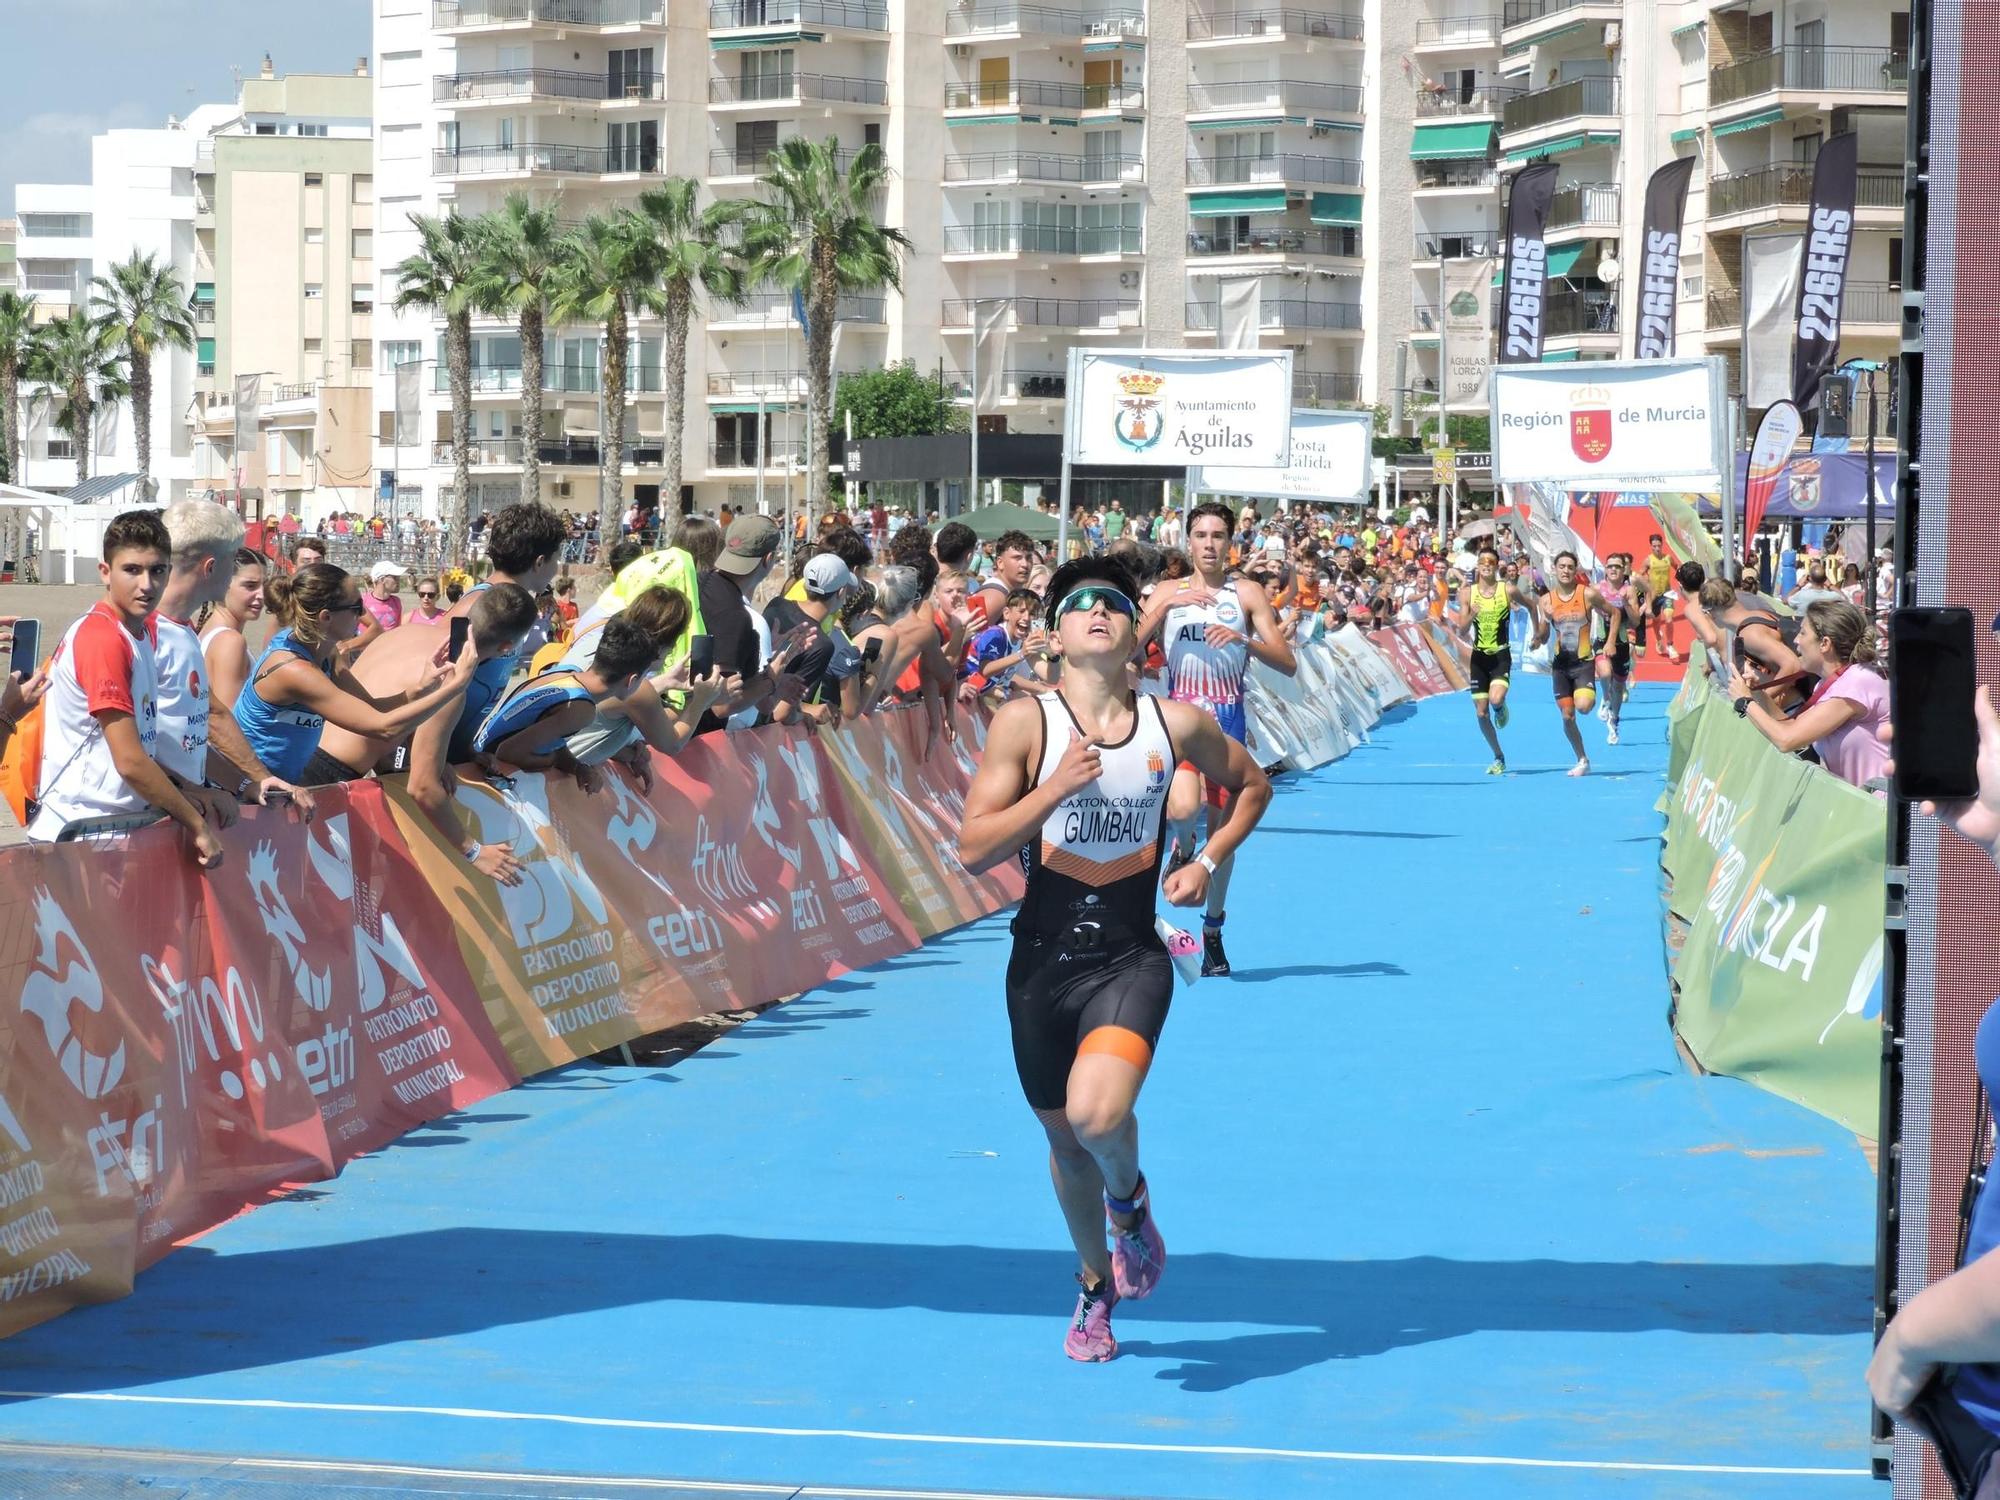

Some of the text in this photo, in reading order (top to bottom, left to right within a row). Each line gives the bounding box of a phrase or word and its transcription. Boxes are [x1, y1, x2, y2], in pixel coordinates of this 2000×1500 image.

[1799, 207, 1851, 341] 226ERS
[1506, 236, 1546, 358] 226ERS
[1453, 367, 1482, 376] LORCA
[1457, 383, 1479, 393] 1988
[1174, 400, 1257, 416] Ayuntamiento
[1207, 414, 1223, 427] de
[1501, 404, 1706, 431] Región de Murcia
[1174, 425, 1254, 456] Águilas
[1060, 797, 1157, 809] CAXTON COLLEGE
[1064, 811, 1147, 844] GUMBAU
[522, 929, 614, 978] PATRONATO
[532, 960, 621, 1008] DEPORTIVO
[363, 993, 440, 1044] PATRONATO
[297, 1014, 356, 1096] etri
[376, 1024, 452, 1076] DEPORTIVO
[392, 1058, 466, 1105] MUNICIPAL
